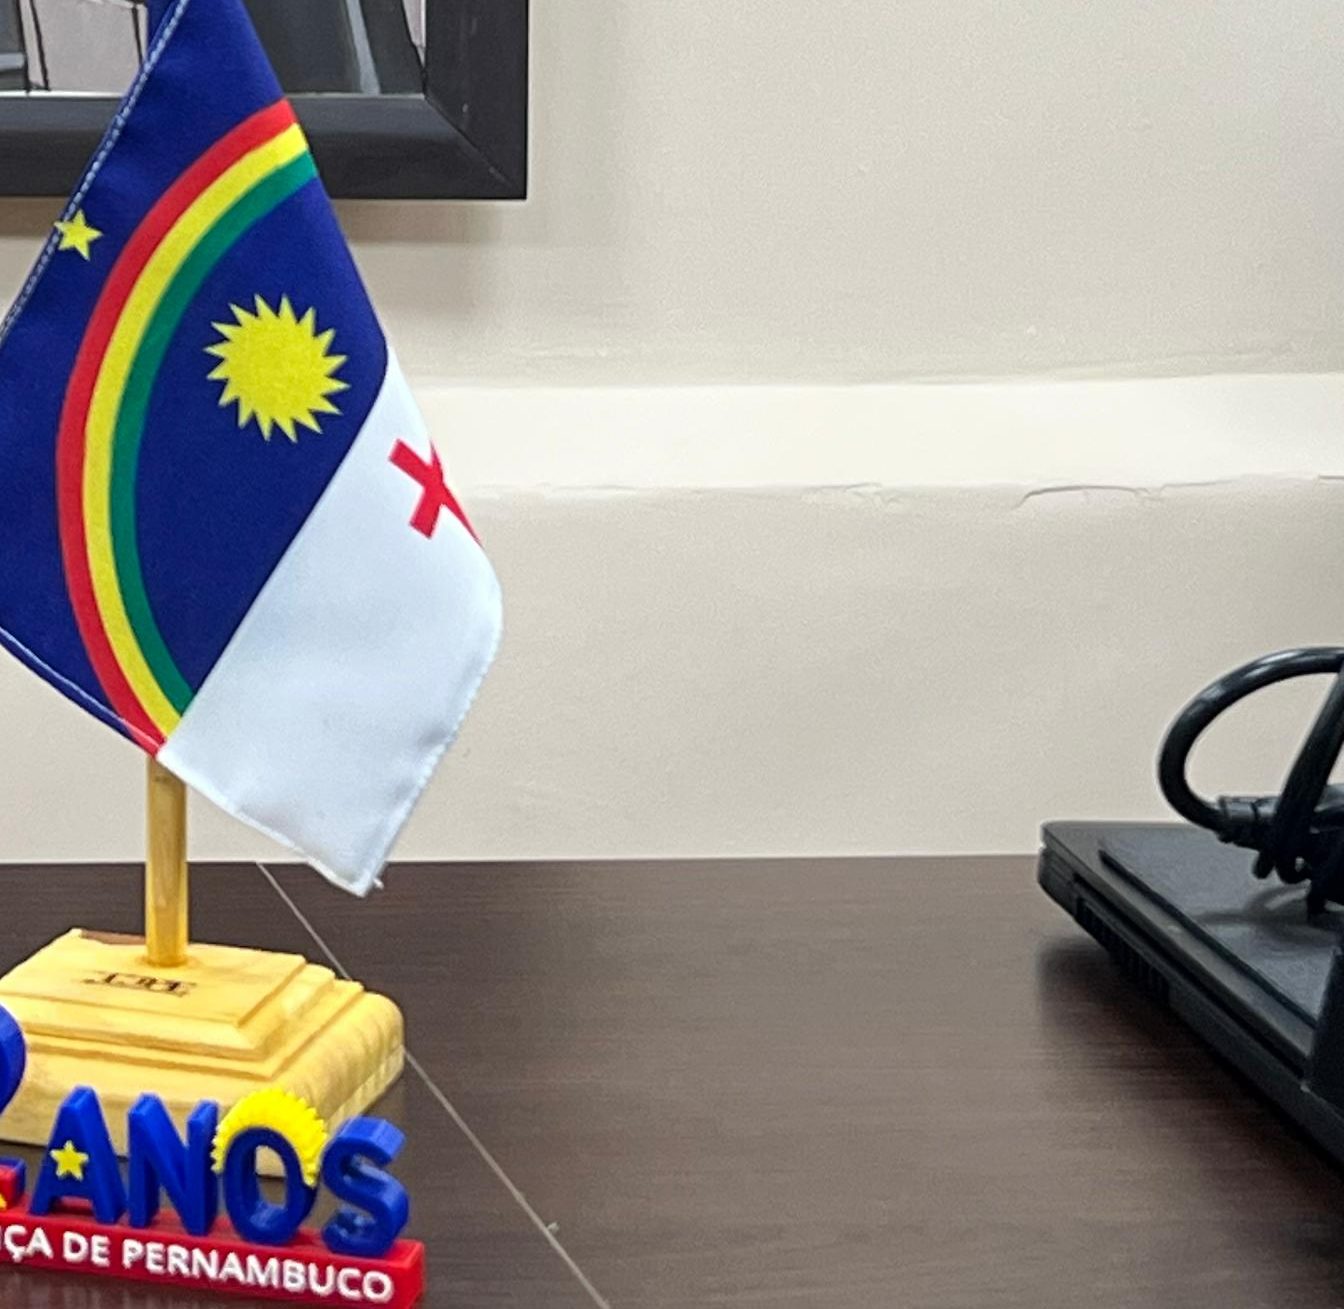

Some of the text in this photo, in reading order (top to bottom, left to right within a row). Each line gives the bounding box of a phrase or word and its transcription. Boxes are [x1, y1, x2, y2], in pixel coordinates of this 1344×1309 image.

[28, 1085, 409, 1259] ANOS
[62, 1230, 110, 1267] DE
[122, 1238, 394, 1303] PERNAMBUCO
